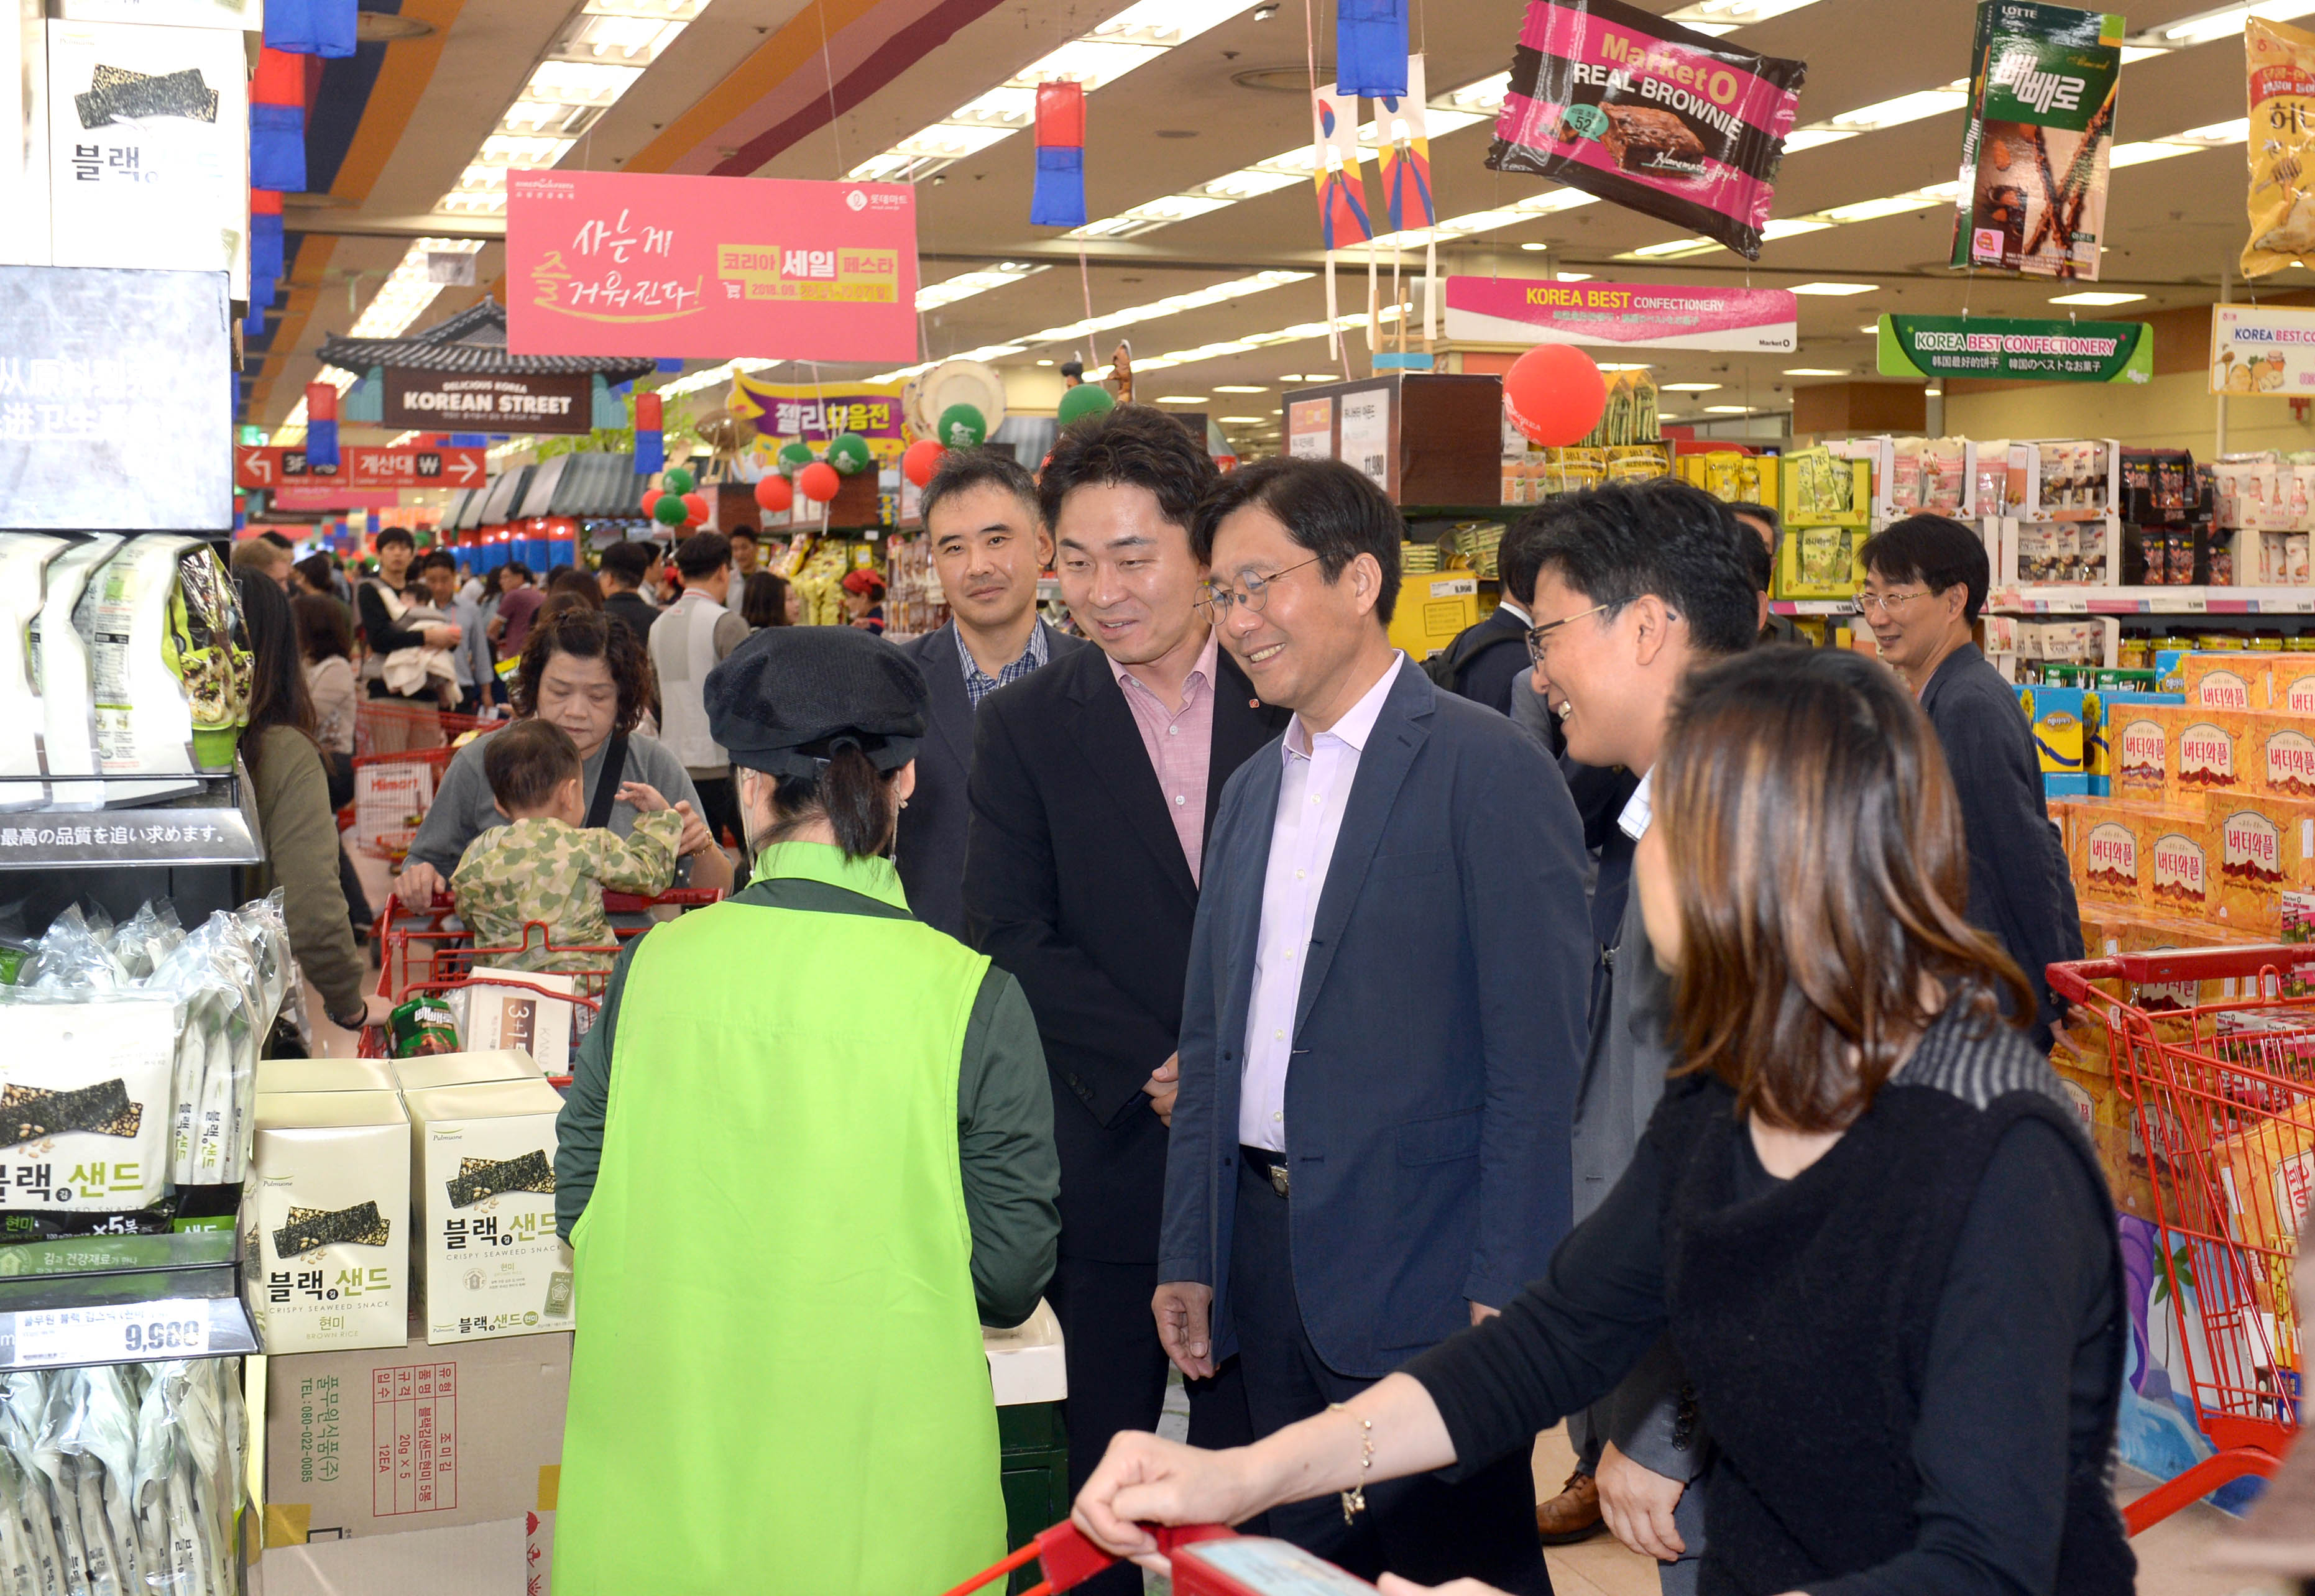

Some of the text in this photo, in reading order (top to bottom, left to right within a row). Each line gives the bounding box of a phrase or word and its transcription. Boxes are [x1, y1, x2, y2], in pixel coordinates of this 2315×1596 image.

[2002, 5, 2038, 19] LOTTE
[1601, 33, 1738, 105] Market O
[1994, 52, 2086, 114] 빼빼로
[1573, 63, 1744, 142] REAL BROWNIE
[1575, 116, 1592, 132] 52
[71, 144, 140, 183] 블랙
[724, 250, 895, 278] 코리아 세일 페스타
[1526, 287, 1726, 312] KOREA BEST CONFECTIONERY
[1783, 339, 1790, 347] O
[1917, 333, 2116, 356] KOREA BEST CONFECTIONERY
[2234, 327, 2273, 341] KOREA
[2275, 329, 2301, 342] BEST
[404, 392, 572, 415] KOREAN STREET
[775, 403, 890, 434] 젤리 모음전
[360, 454, 415, 475] 계산대
[2203, 687, 2244, 707] 버터와플
[2126, 736, 2165, 761] 버터와플
[2184, 741, 2227, 766] 버터와플
[2270, 748, 2315, 776] 버터와플
[1, 825, 224, 847] 最高の品質を追い求めます。
[2229, 830, 2273, 861] 버터와플
[2092, 840, 2132, 867] 버터와플
[2158, 851, 2201, 881] 버터와플
[203, 1109, 221, 1138] 블랙
[202, 1141, 218, 1169] 샌드
[68, 1162, 144, 1198] 샌드
[6, 1214, 35, 1232] 현미
[443, 1216, 497, 1249] 블랙
[509, 1213, 557, 1242] 샌드
[446, 1245, 561, 1261] CRISPY SEAWEED SNACK
[267, 1270, 323, 1303] 블랙
[335, 1267, 392, 1297] 샌드
[269, 1300, 390, 1314] CRISPY SEAWEED SNACK
[306, 1331, 338, 1340] BROWN
[319, 1316, 344, 1331] 현미
[458, 1316, 487, 1334] 블랙
[494, 1314, 522, 1329] 샌드
[316, 1375, 339, 1482] 풀무원식품(주)
[398, 1434, 411, 1455] 20g
[418, 1406, 432, 1502] 블랙김샌드현미 5봉
[379, 1444, 390, 1474] 12EA
